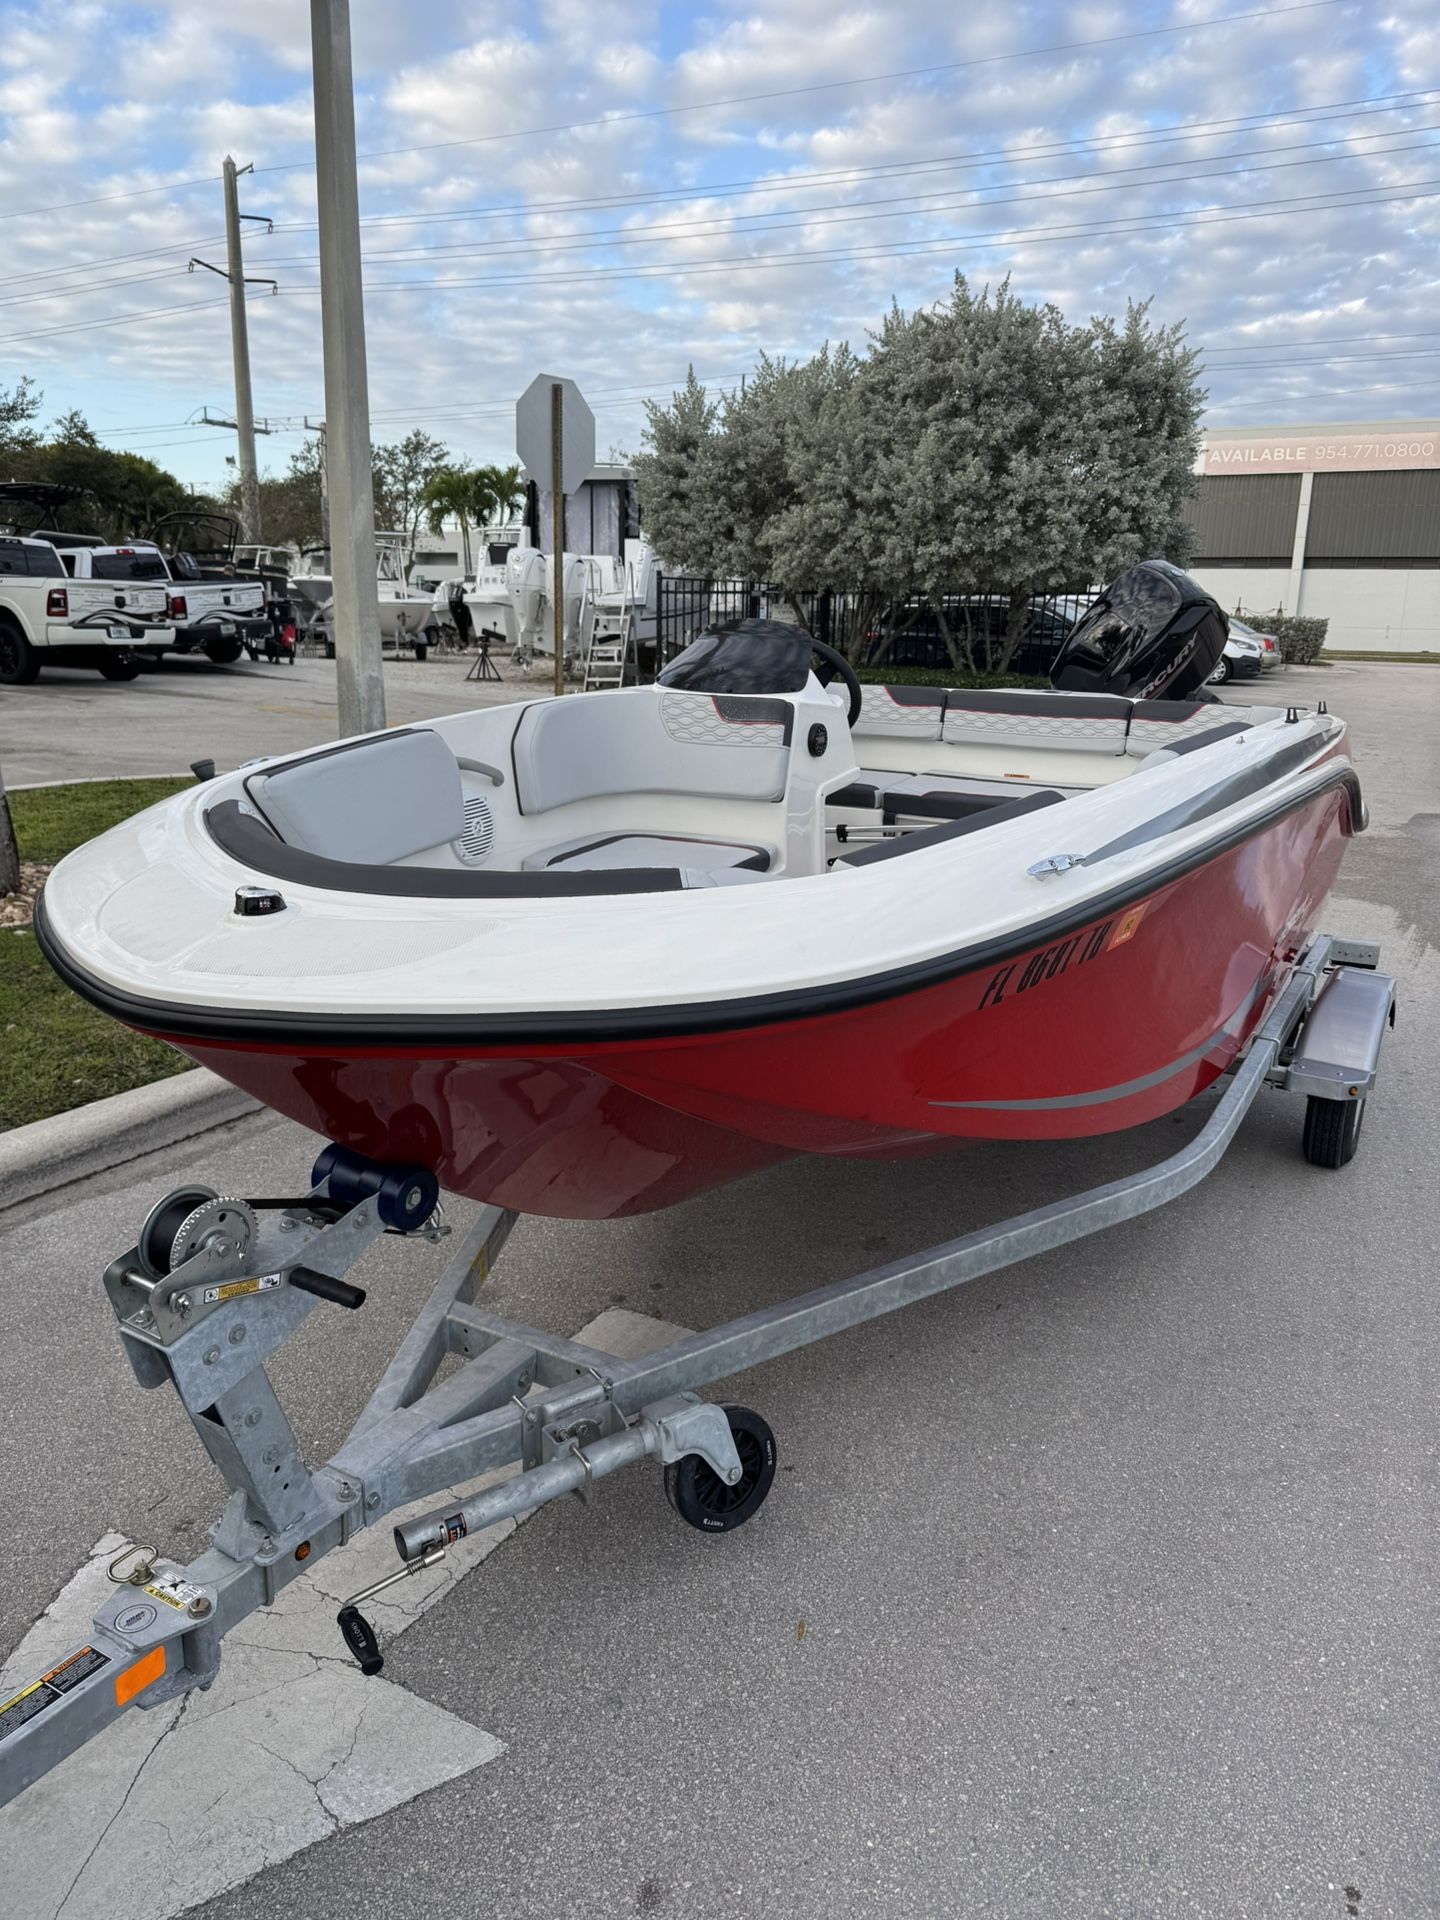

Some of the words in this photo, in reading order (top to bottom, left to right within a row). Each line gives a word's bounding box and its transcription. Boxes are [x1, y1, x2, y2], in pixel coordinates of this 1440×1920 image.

[1209, 447, 1307, 463] AVAILABLE
[1314, 442, 1434, 460] 954.771.0800
[977, 963, 1017, 1010] FL
[155, 1590, 180, 1607] CAUTION
